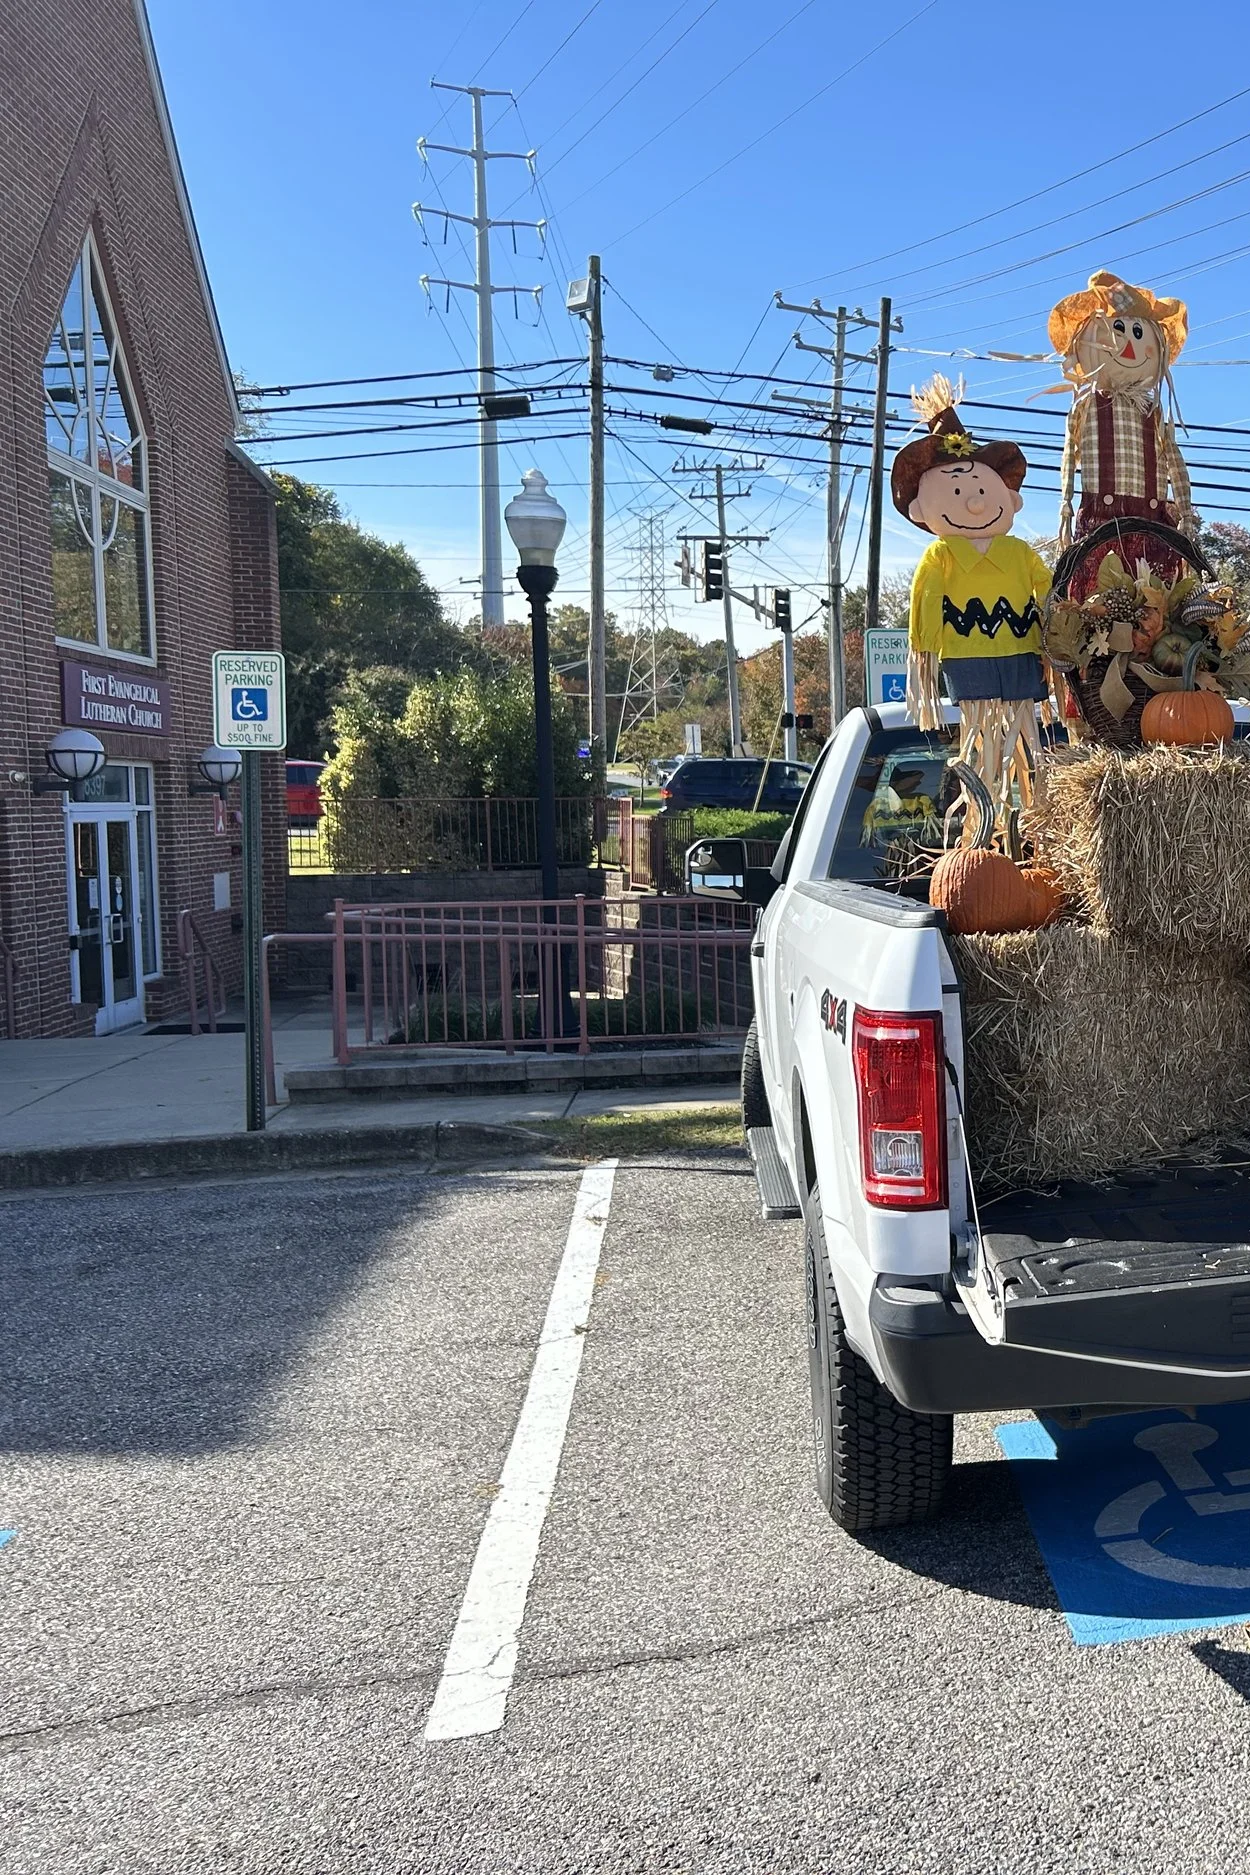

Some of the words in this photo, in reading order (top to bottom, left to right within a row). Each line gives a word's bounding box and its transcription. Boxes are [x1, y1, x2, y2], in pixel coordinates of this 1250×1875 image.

[219, 660, 278, 672] RESERVED
[225, 674, 273, 686] PARKING
[81, 669, 106, 696] FIRST
[107, 674, 161, 705] EVANGELICAL
[80, 696, 127, 725] LUTHERAN
[128, 704, 162, 729] CHURCH
[237, 723, 249, 732] UP
[253, 723, 263, 732] TO
[228, 733, 252, 744] $500
[255, 734, 273, 743] FINE
